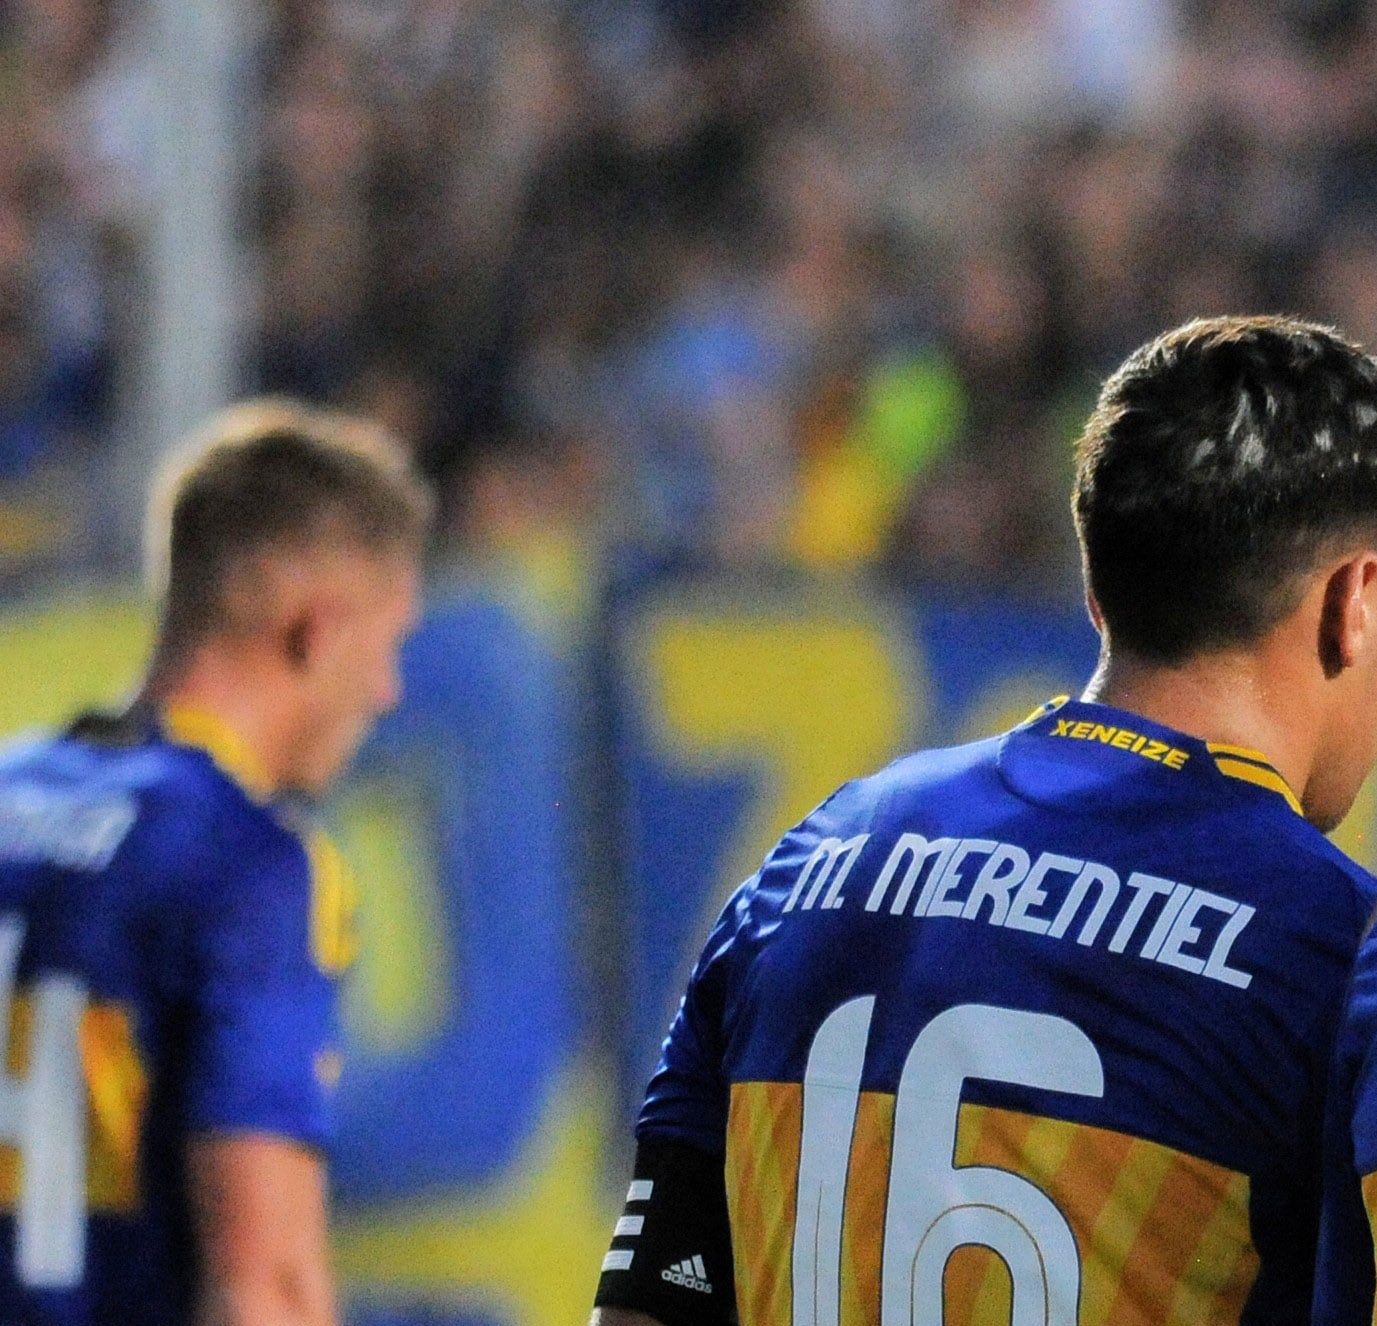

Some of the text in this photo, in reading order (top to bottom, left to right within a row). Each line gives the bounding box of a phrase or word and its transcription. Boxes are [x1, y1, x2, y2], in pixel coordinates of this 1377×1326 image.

[1049, 719, 1190, 770] XENEIZE
[782, 833, 1256, 990] M. MERENTIEL
[661, 1270, 712, 1294] adidas
